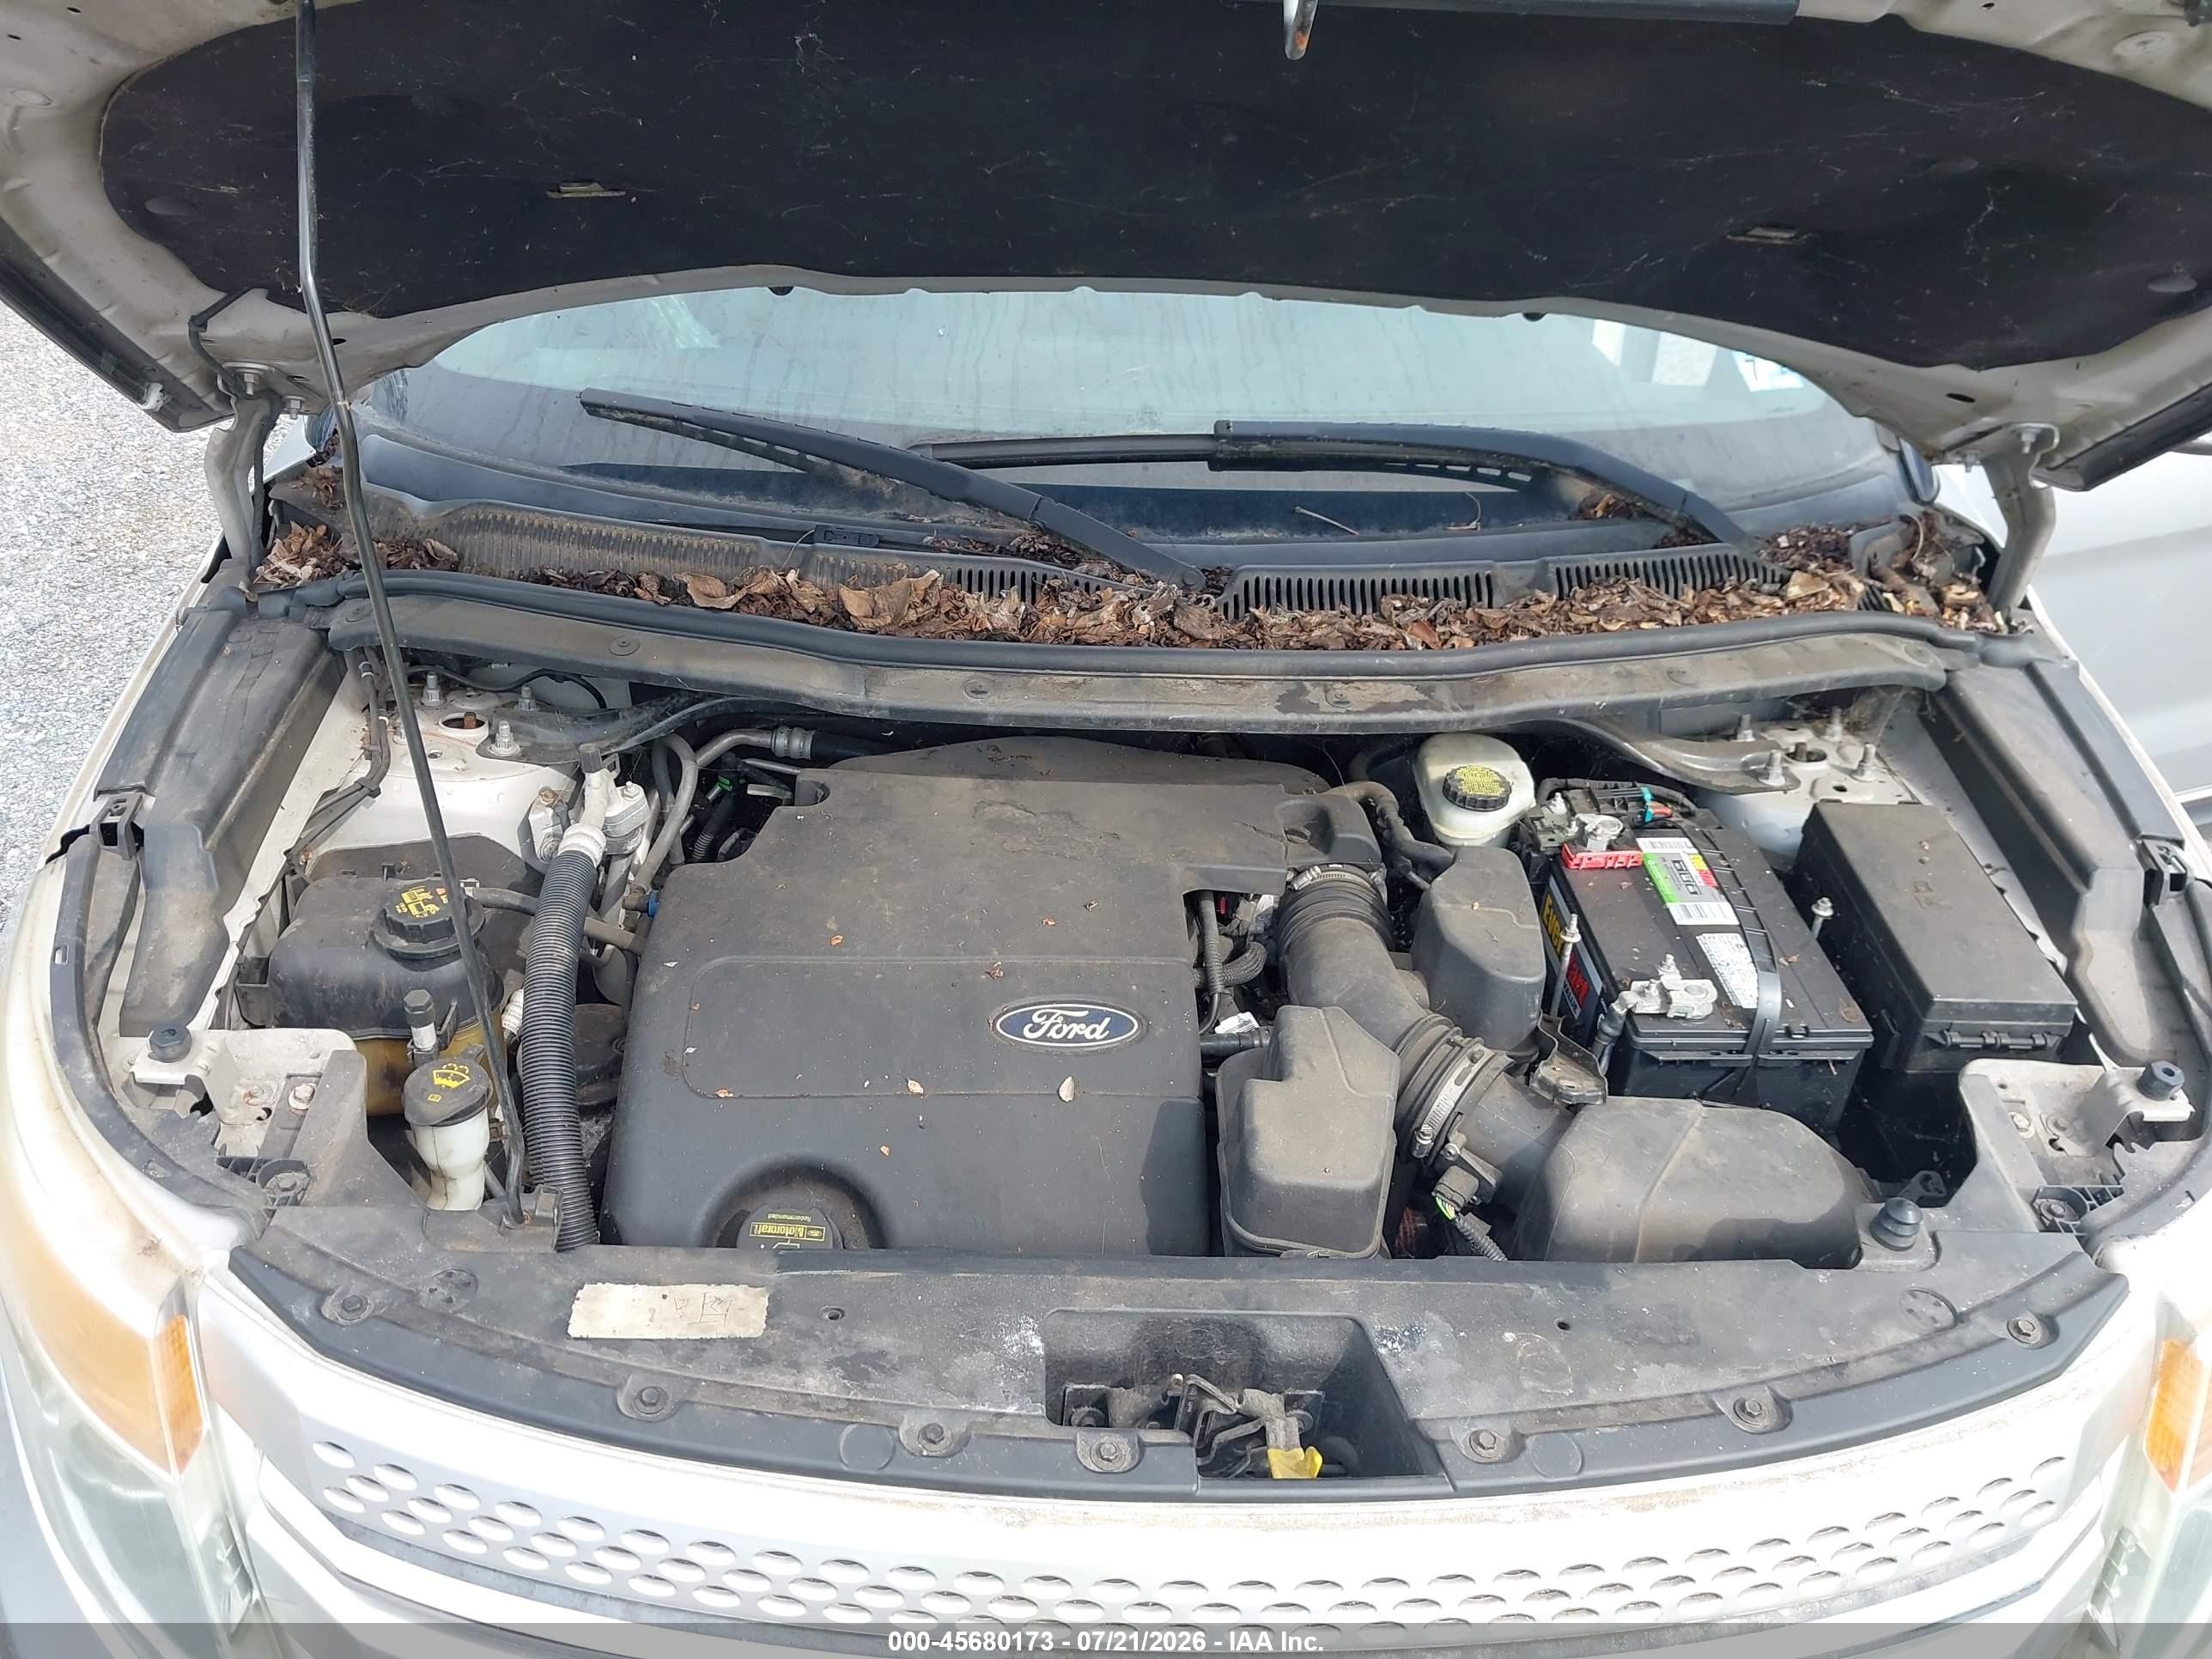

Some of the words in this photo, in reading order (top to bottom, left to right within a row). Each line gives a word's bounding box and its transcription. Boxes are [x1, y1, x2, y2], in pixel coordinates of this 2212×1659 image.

[1023, 1008, 1111, 1040] Ford
[768, 1212, 811, 1223] Recommended
[752, 1224, 805, 1237] Motorcraft
